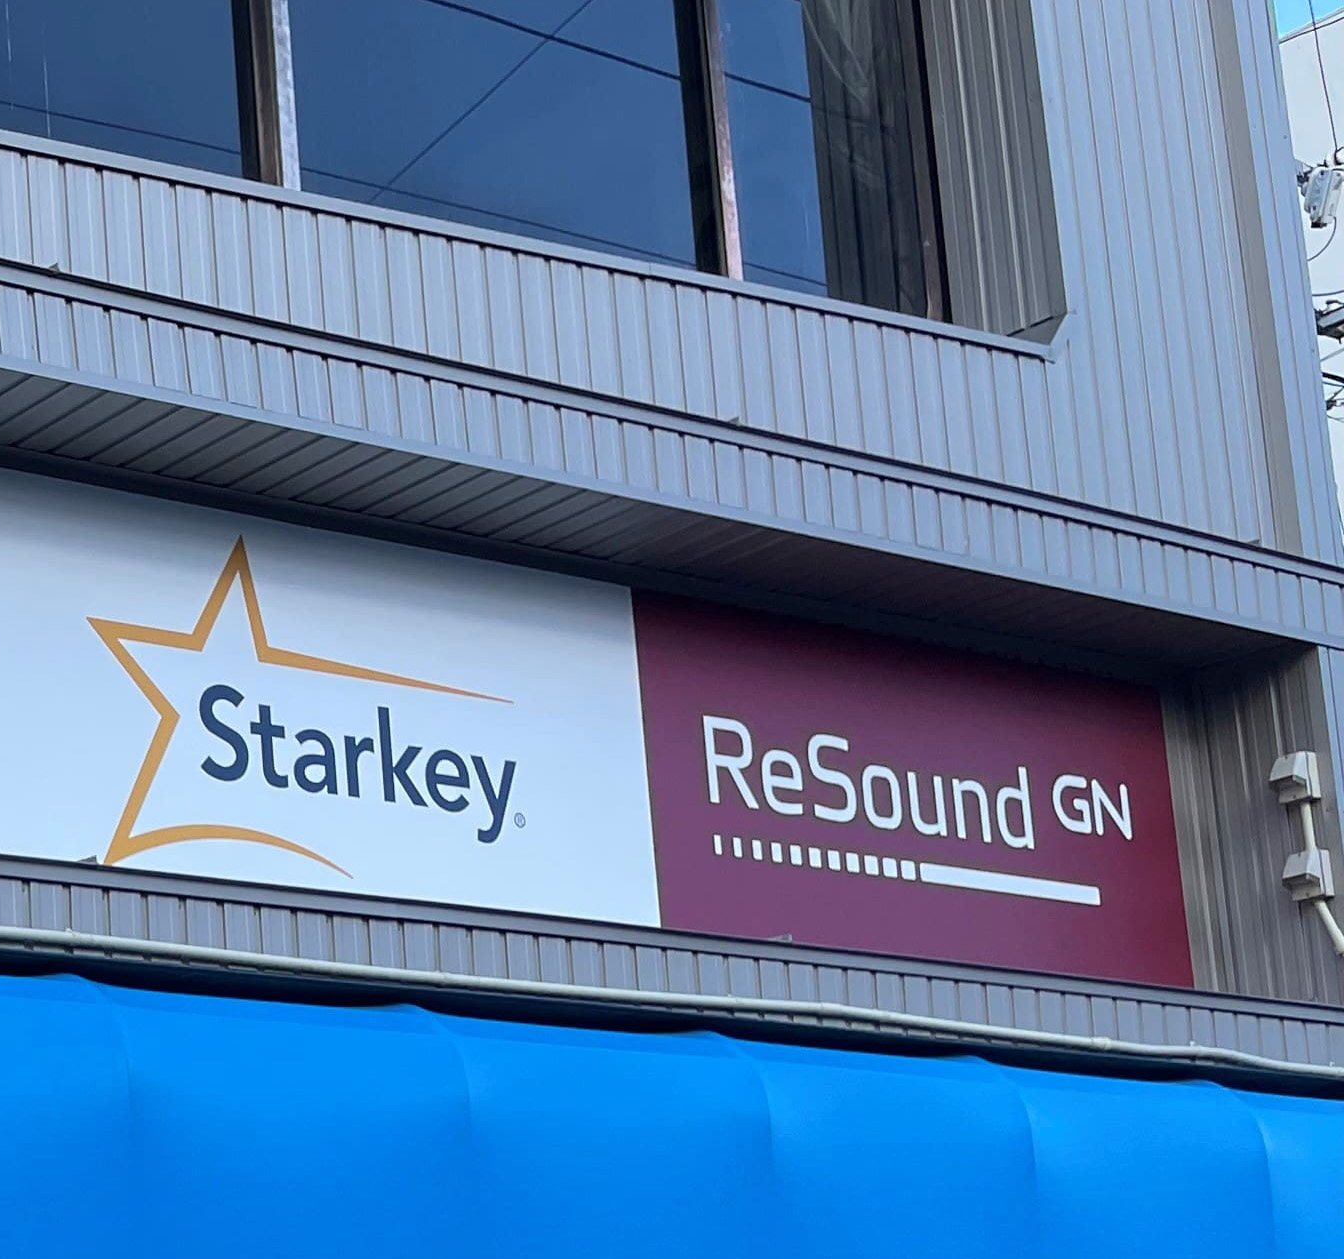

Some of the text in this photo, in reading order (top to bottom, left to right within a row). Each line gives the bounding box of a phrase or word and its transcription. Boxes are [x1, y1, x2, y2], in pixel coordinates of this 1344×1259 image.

[198, 684, 517, 843] Starkey
[702, 714, 1133, 849] ReSound GN
